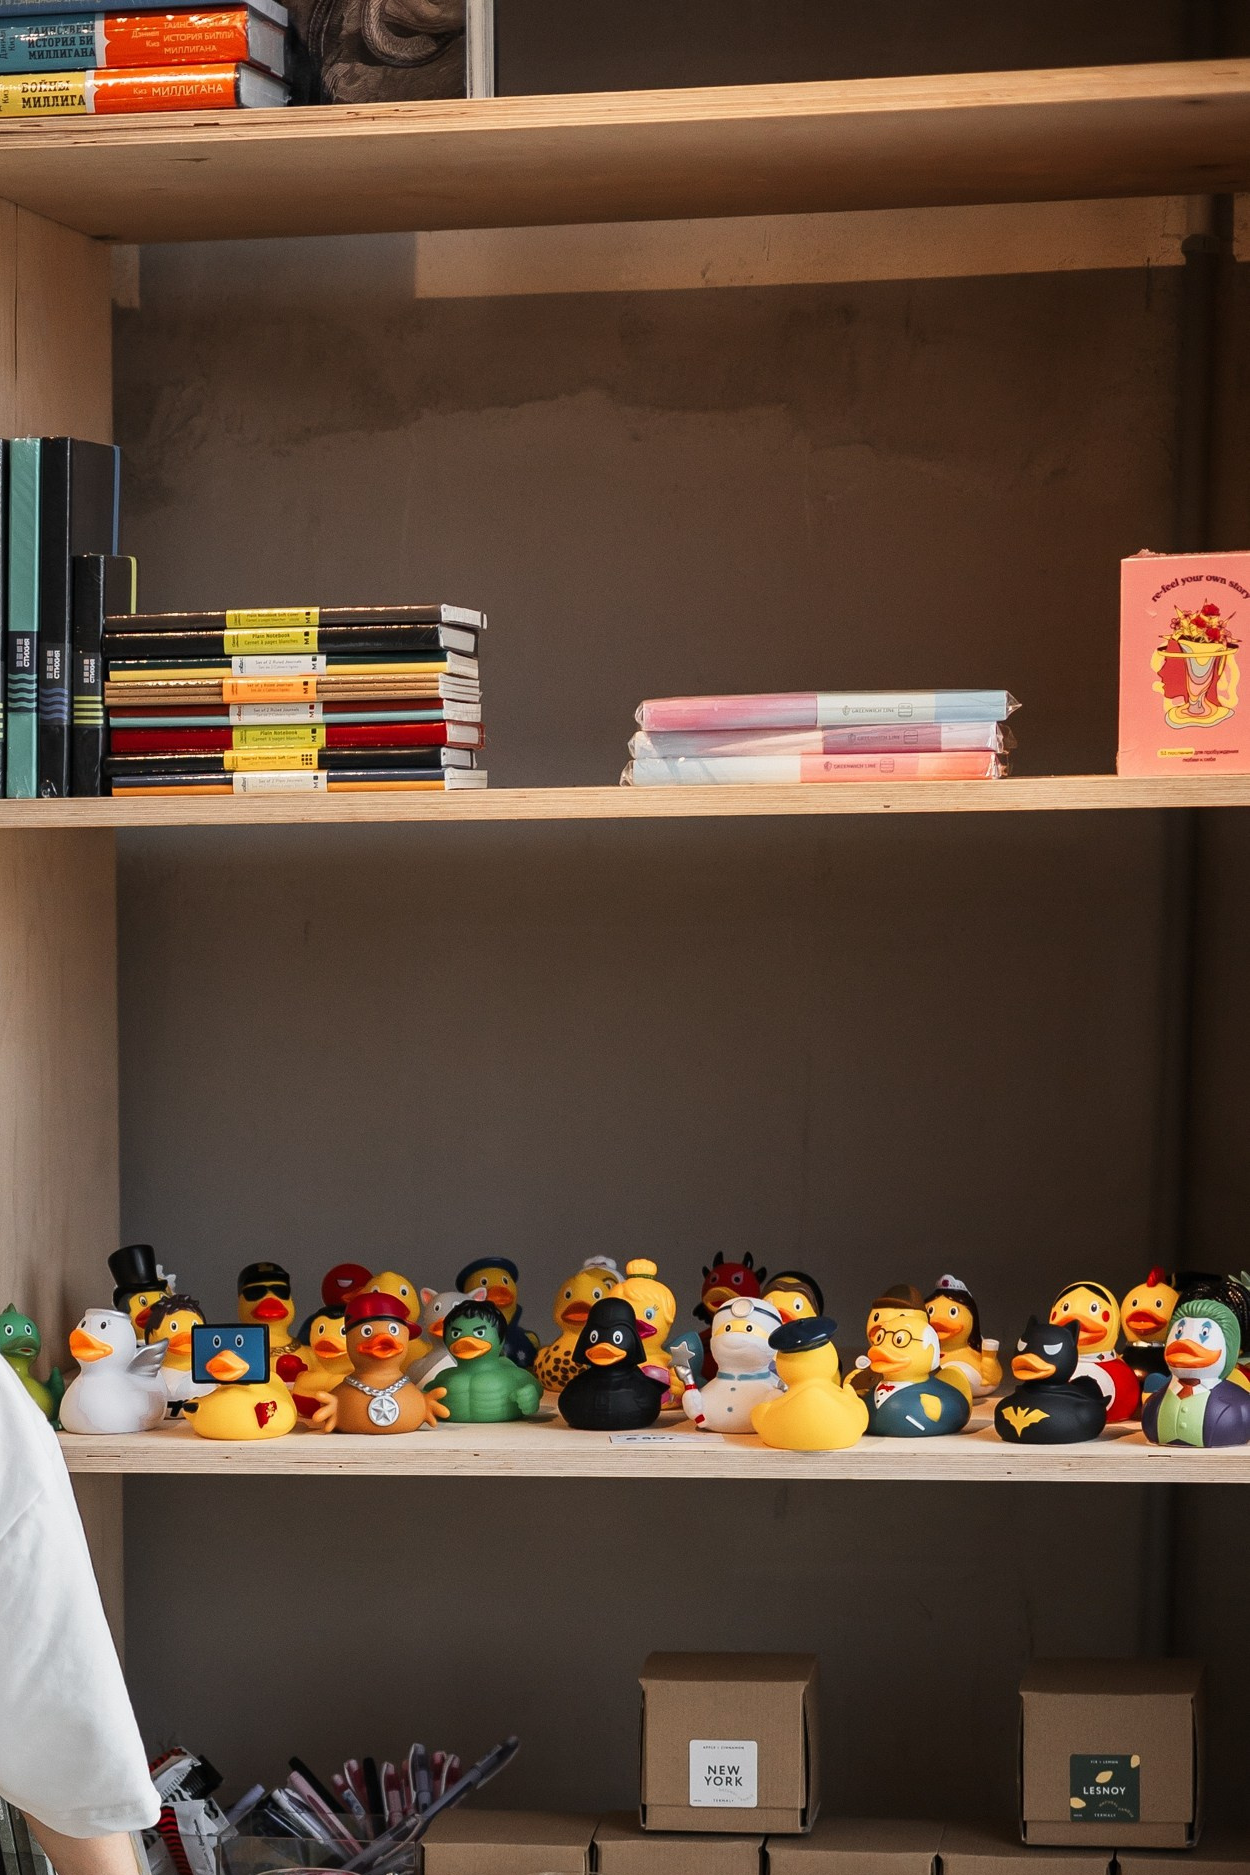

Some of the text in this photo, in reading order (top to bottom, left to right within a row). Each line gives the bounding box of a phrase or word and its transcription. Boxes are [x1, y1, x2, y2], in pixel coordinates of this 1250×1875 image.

[28, 36, 70, 49] ИСТОРИЯ
[163, 33, 203, 42] ИСТОРИЯ
[28, 47, 96, 60] МИЛЛИГАНА
[163, 45, 217, 54] МИЛЛИГАНА
[133, 83, 224, 97] Киз МИЛЛИГАНА
[21, 93, 86, 108] МИЛЛИГА
[1152, 574, 1227, 603] re-feel your own
[707, 1765, 741, 1776] NEW
[704, 1776, 743, 1787] YORK
[1083, 1786, 1126, 1795] LESNOY
